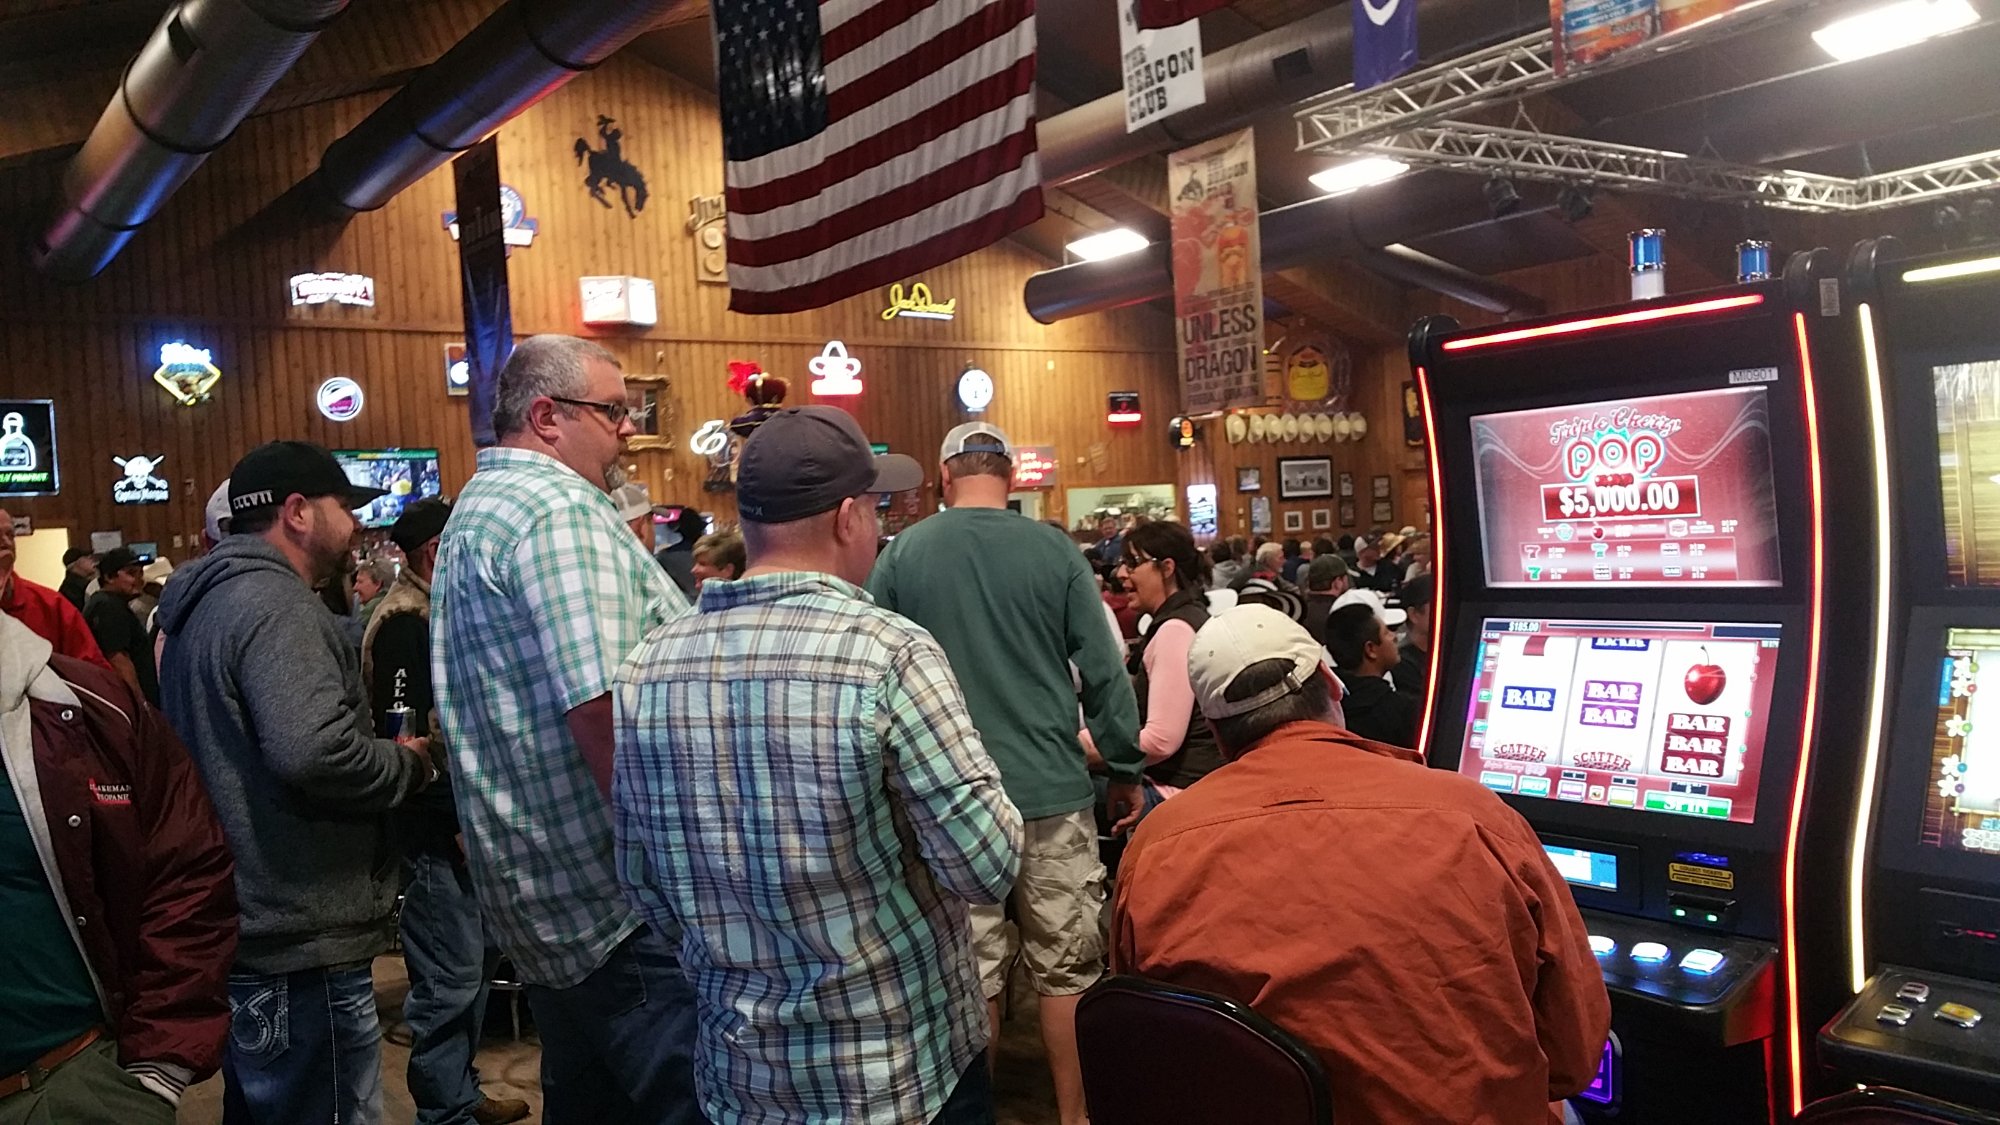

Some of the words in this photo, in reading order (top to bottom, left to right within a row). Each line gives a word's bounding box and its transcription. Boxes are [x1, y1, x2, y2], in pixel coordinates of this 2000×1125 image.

[1127, 46, 1195, 98] BEACON
[1129, 86, 1168, 123] CLUB
[1182, 303, 1257, 345] UNLESS
[1185, 345, 1258, 382] DRAGON
[1550, 411, 1609, 445] Triple
[1610, 405, 1682, 439] Cherry
[1564, 432, 1664, 481] POP
[1559, 481, 1680, 518] $5,000.00
[1508, 621, 1540, 633] $185.00
[1505, 688, 1552, 708] BAR
[1586, 682, 1639, 701] BAR
[1582, 707, 1635, 727] BAR
[1671, 714, 1726, 733] BAR
[1493, 743, 1546, 762] SCATTER
[1668, 735, 1723, 755] BAR
[1572, 751, 1632, 771] SCATTER
[1664, 756, 1720, 776] BAR
